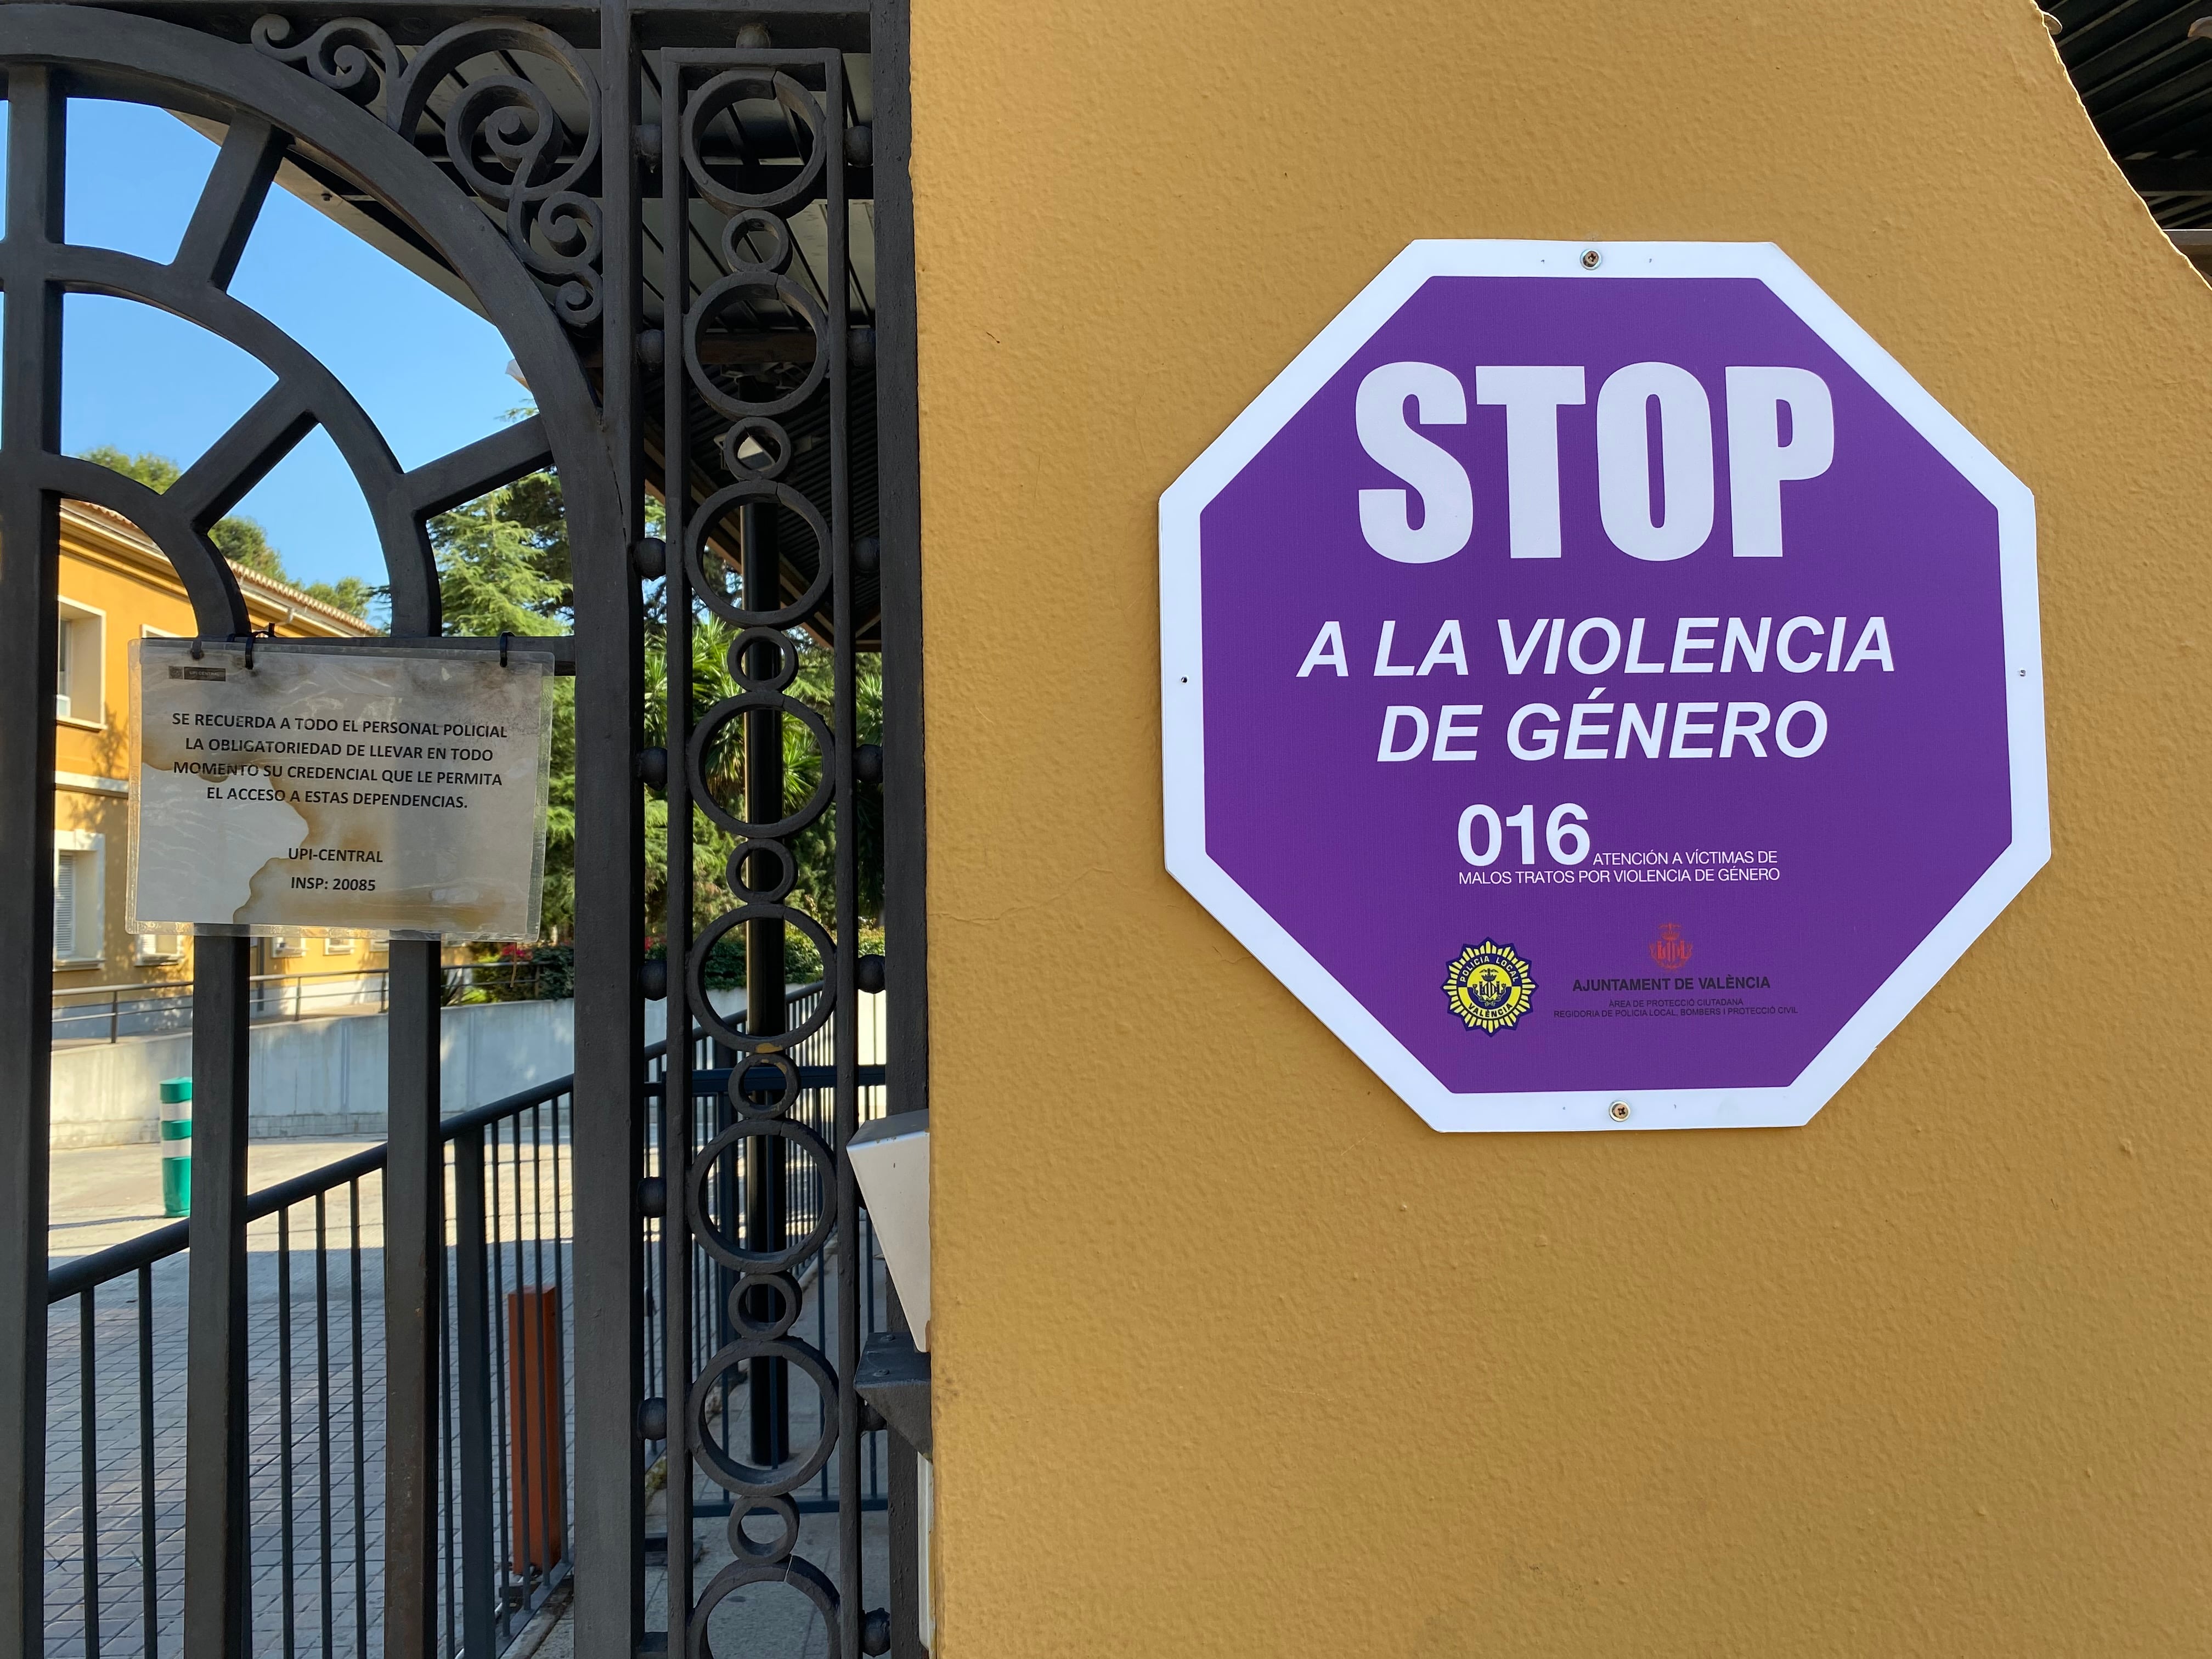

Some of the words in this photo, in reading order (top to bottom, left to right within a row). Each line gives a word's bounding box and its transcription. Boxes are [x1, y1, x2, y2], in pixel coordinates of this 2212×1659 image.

[1355, 361, 1834, 564] STOP
[1296, 620, 1349, 678] A
[1373, 619, 1469, 677] LA
[1497, 616, 1894, 675] VIOLENCIA
[172, 713, 190, 726] SE
[195, 714, 276, 729] RECUERDA
[280, 716, 291, 730] A
[295, 717, 338, 731] TODO
[343, 719, 359, 732] EL
[363, 720, 438, 736] PERSONAL
[443, 724, 507, 738] POLICIAL
[1376, 704, 1483, 762] DE
[1506, 687, 1828, 761] GÉNERO
[185, 737, 204, 751] LA
[208, 738, 342, 756] OBLIGATORIEDAD
[347, 743, 365, 757] DE
[369, 744, 423, 759] LLEVAR
[427, 747, 447, 760] EN
[450, 748, 493, 762] TODO
[173, 761, 259, 777] MOMENTO
[263, 765, 283, 778] SU
[287, 765, 378, 781] CREDENCIAL
[382, 769, 414, 785] QUE
[417, 770, 433, 783] LE
[437, 771, 503, 786] PERMITA
[207, 786, 223, 799] EL
[227, 787, 286, 802] ACCESO
[289, 791, 300, 803] A
[304, 791, 349, 804] ESTAS
[353, 792, 468, 809] DEPENDENCIAS.
[1457, 803, 1590, 867] 016
[288, 848, 383, 864] UPI-CENTRAL
[1593, 850, 1668, 865] ATENCIÓN
[1672, 853, 1683, 865] A
[1685, 849, 1754, 864] VÍCTIMAS
[1758, 851, 1778, 863] DE
[291, 877, 328, 890] INSP:
[332, 878, 376, 892] 20085
[1459, 871, 1511, 884] MALOS
[1515, 871, 1575, 884] TRATOS
[1579, 870, 1611, 883] POR
[1613, 868, 1691, 882] VIOLENCIA
[1695, 868, 1714, 881] DE
[1718, 866, 1780, 881] GÉNERO
[1460, 956, 1489, 982] POLICIA
[1496, 957, 1519, 982] LOCAL
[1573, 979, 1671, 991] AJUNTAMENT
[1675, 978, 1694, 990] DE
[1699, 974, 1770, 989] VALÈNCIA
[1468, 1003, 1513, 1018] VALÈNCIA
[1647, 998, 1695, 1007] PROTECCIÓ
